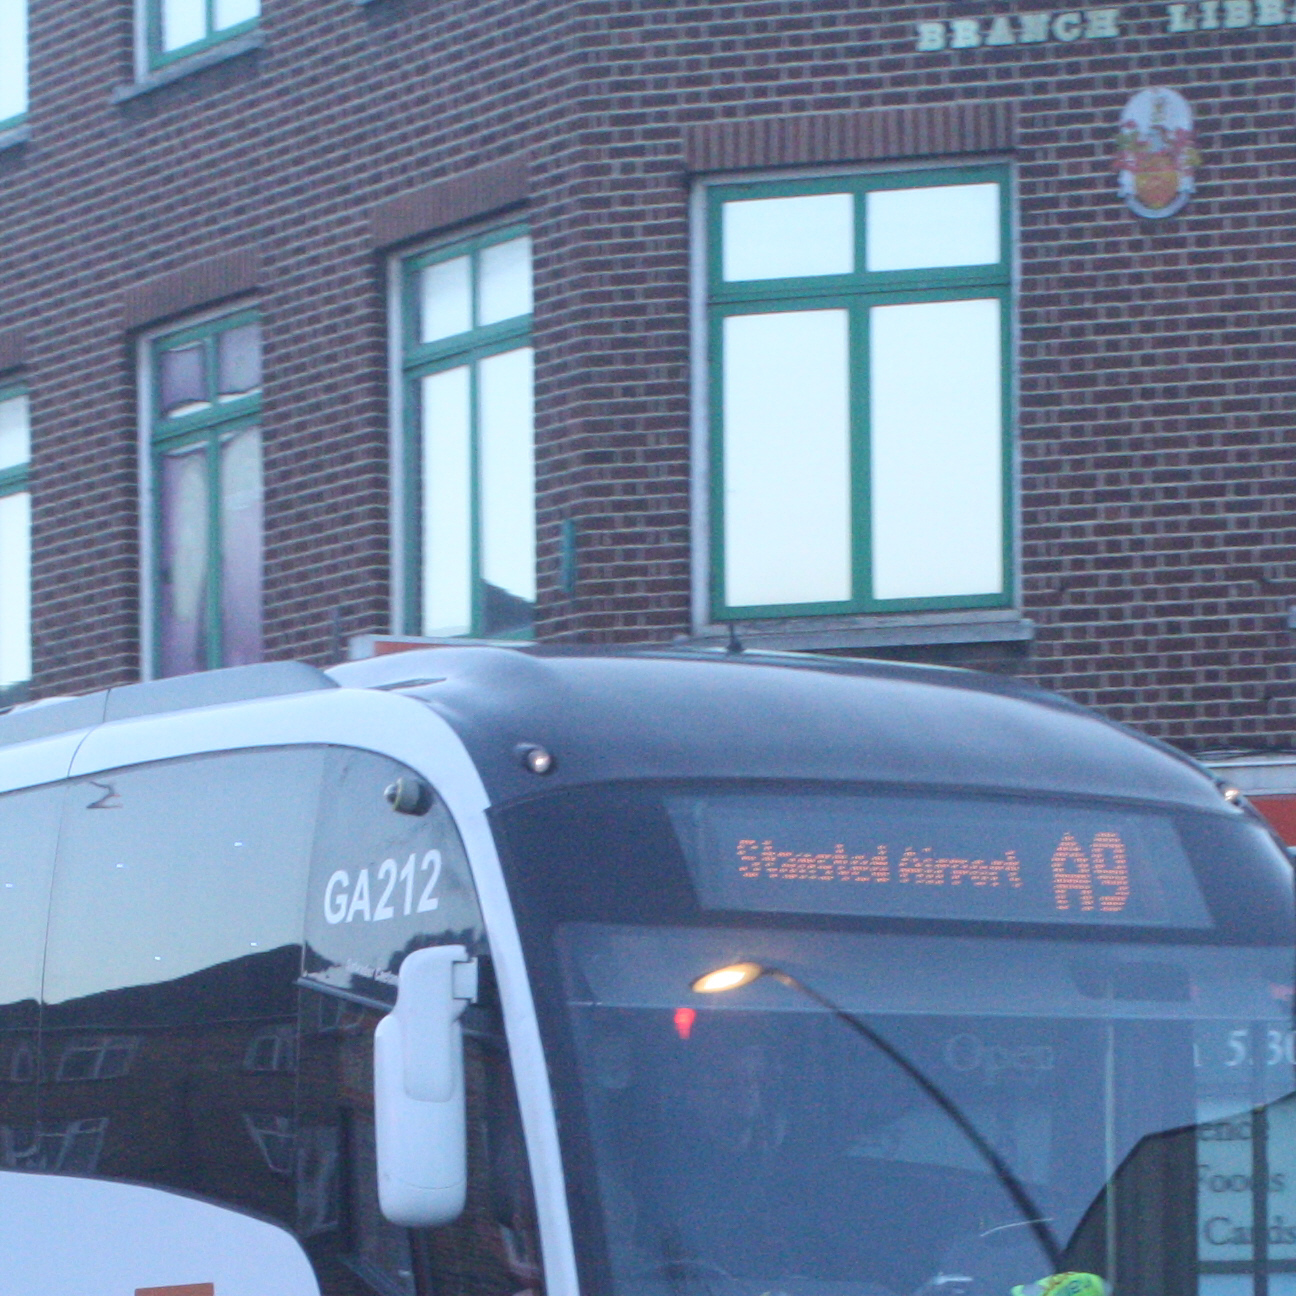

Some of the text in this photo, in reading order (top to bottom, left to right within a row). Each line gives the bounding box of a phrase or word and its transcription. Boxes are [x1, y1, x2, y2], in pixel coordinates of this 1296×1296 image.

[916, 9, 1120, 51] BRANCH
[323, 849, 442, 925] GA212
[736, 839, 1023, 888] Stansted Airport
[1050, 831, 1131, 912] A9
